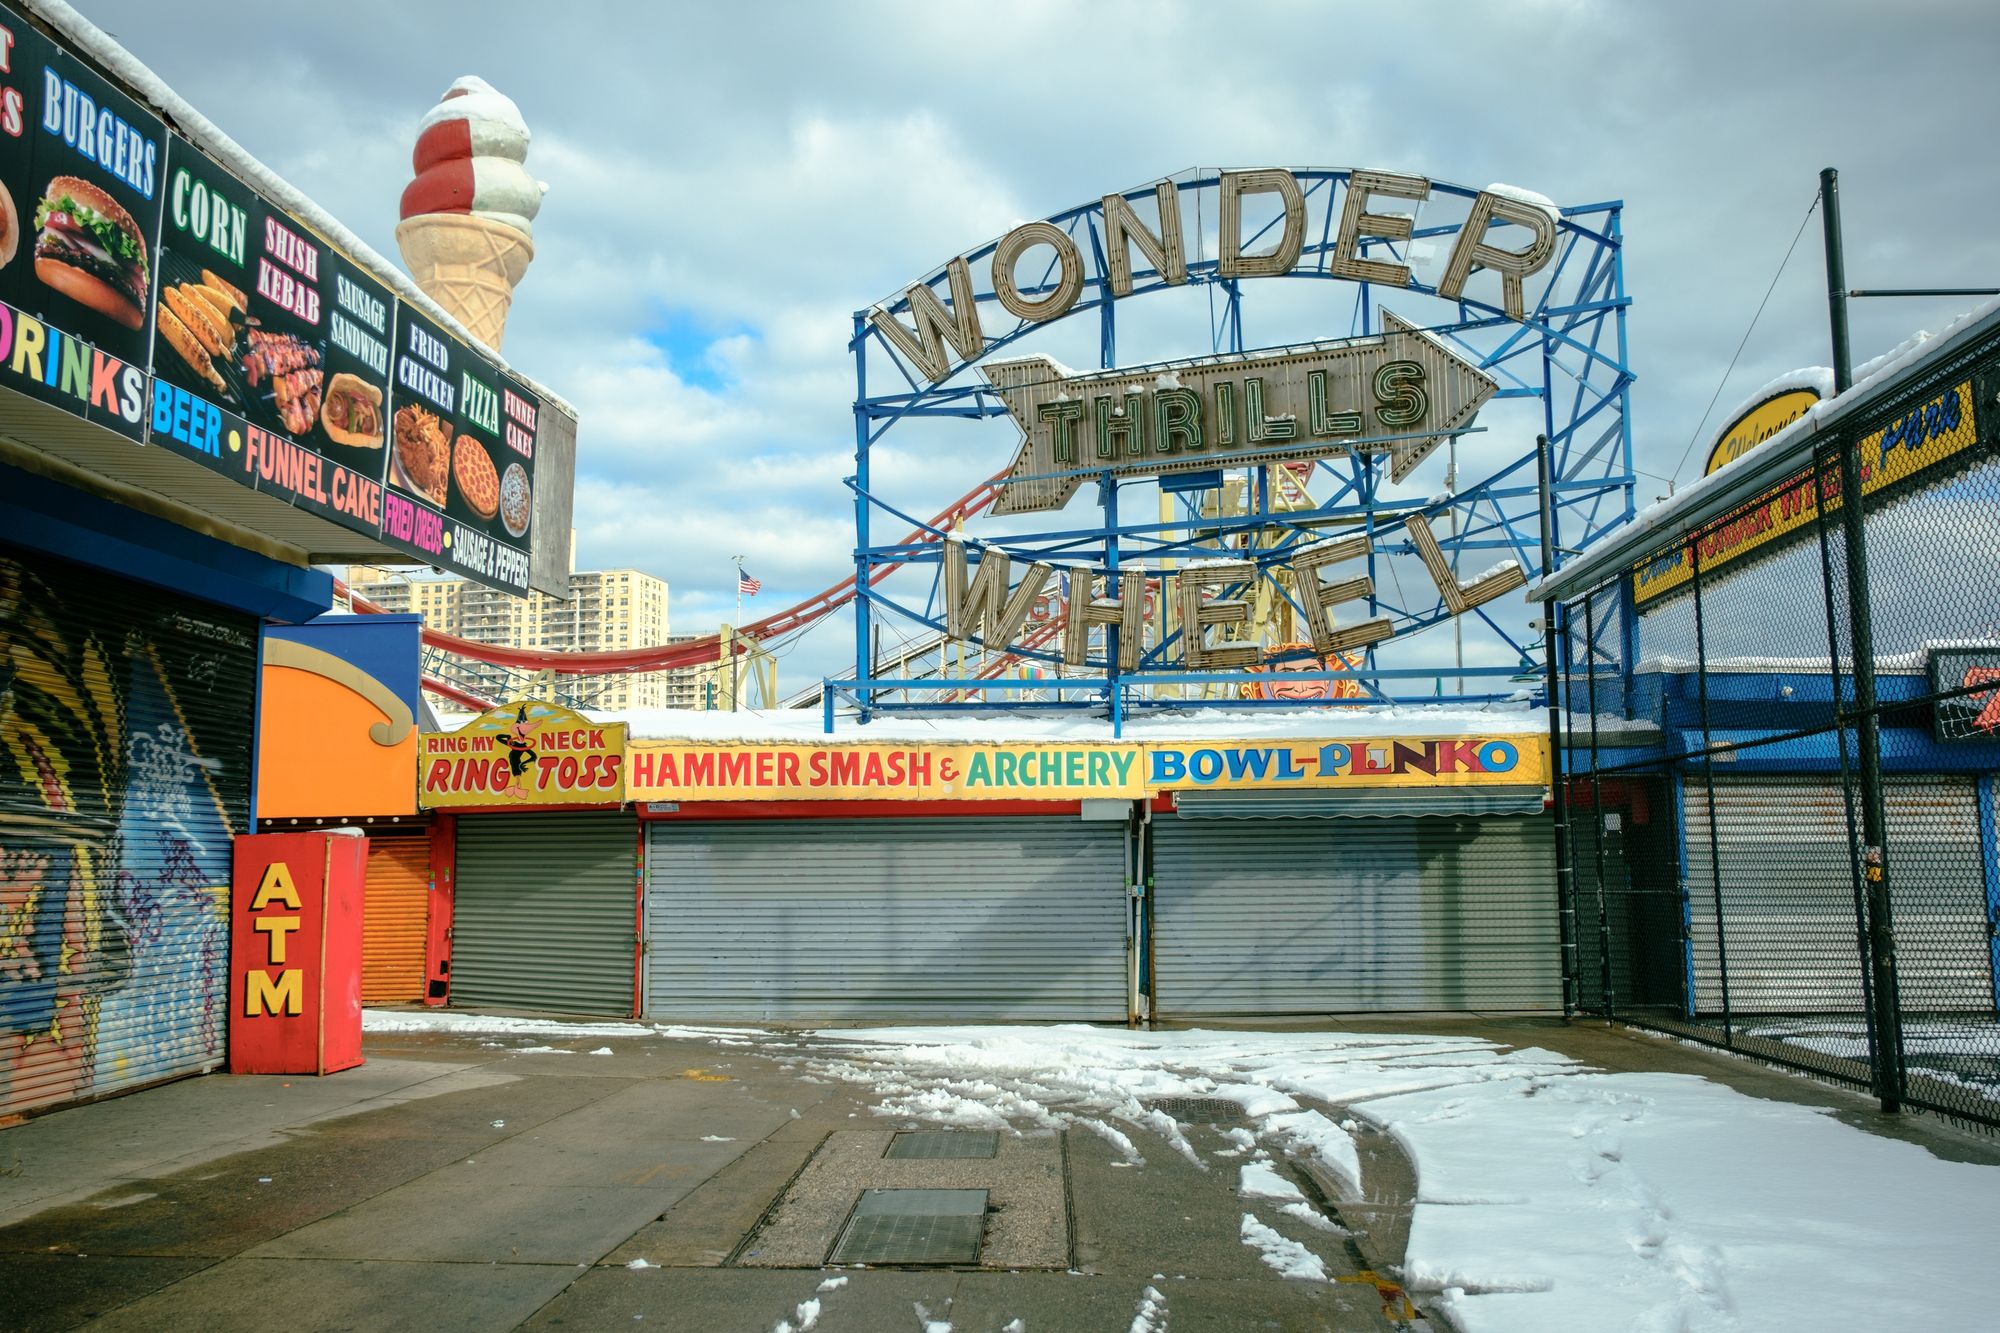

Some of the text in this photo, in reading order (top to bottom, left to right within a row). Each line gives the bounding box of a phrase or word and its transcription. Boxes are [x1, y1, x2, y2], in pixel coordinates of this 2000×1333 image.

[43, 66, 155, 199] BURGERS
[172, 167, 246, 268] CORN
[265, 215, 318, 283] SHISH
[257, 257, 321, 325] KEBAB
[336, 272, 386, 335] SAUSAGE
[869, 167, 1557, 384] WONDER
[330, 310, 388, 378] SANDWICH
[409, 321, 449, 373] FRIED
[399, 354, 455, 414] CHICKEN
[460, 369, 500, 437] PIZZA
[504, 388, 537, 432] FUNNEL
[1037, 360, 1427, 464] THRILLS
[153, 379, 222, 458] BEER
[505, 422, 533, 460] CAKES
[245, 425, 381, 526] FUNNEL CAKE
[383, 494, 442, 556] FRIED OREOS
[452, 525, 529, 589] SAUSAGE & PEPPERS
[943, 513, 1528, 671] WHEEL
[426, 755, 622, 793] RING TOSS
[427, 729, 606, 754] RING MY NECK
[633, 751, 1136, 787] HAMMER SMASH & ARCHERY
[245, 862, 303, 1017] ATM
